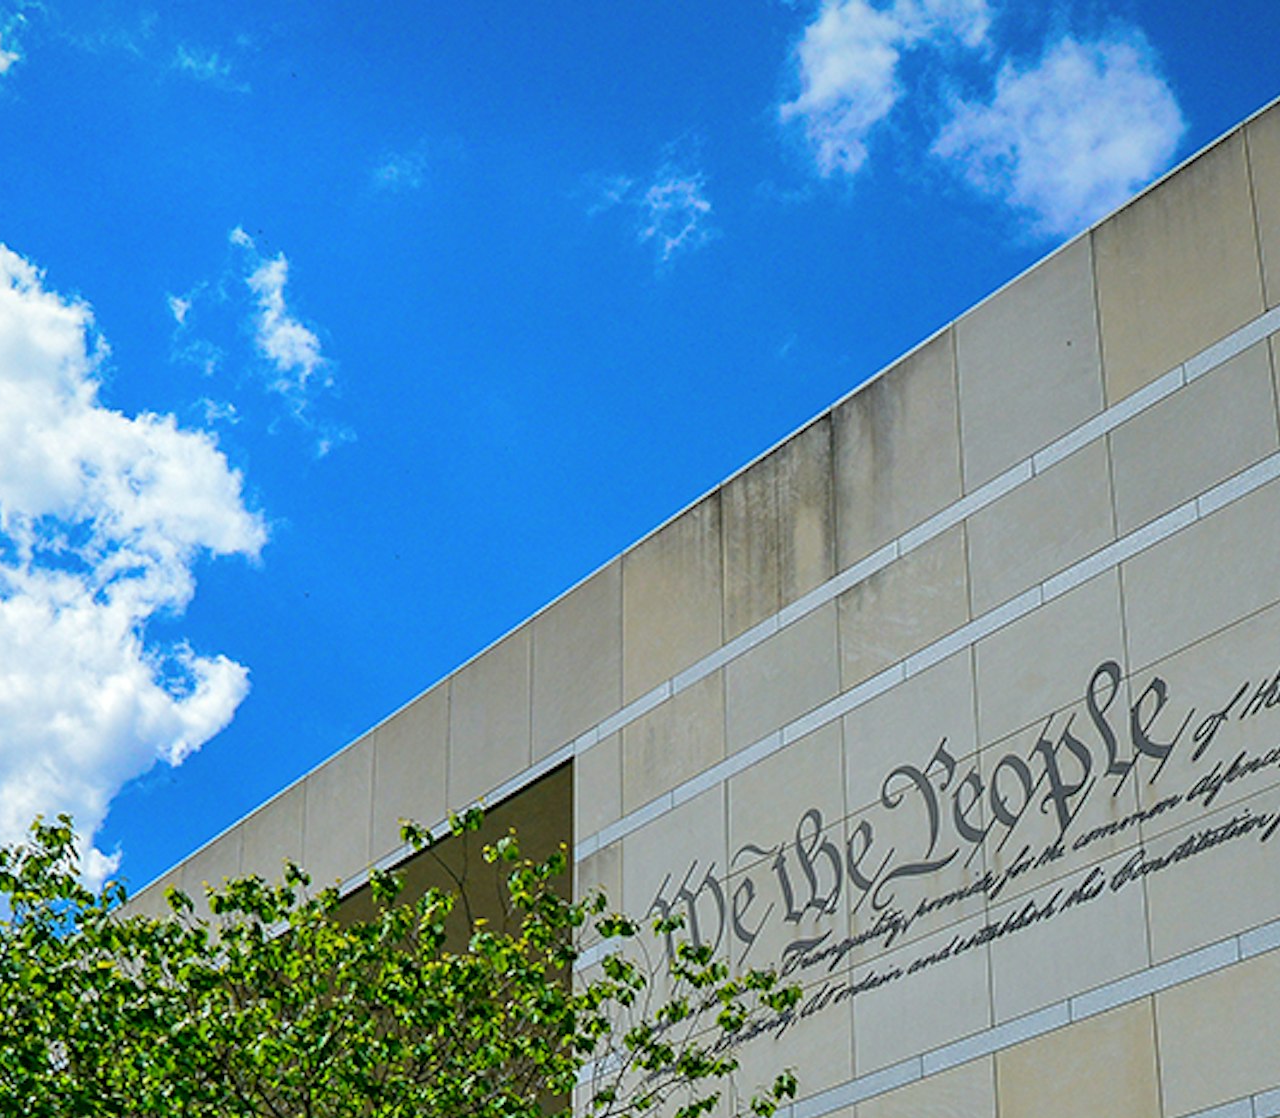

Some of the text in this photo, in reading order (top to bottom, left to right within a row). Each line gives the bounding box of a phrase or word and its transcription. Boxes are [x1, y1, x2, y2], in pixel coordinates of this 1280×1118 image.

[642, 858, 776, 992] We
[870, 659, 1196, 910] People
[1190, 680, 1250, 762] of
[834, 965, 904, 1004] ordain
[906, 935, 961, 975] and
[1059, 866, 1106, 912] this
[1109, 808, 1276, 893] Constitution
[901, 870, 1000, 933] provide
[989, 844, 1036, 900] for
[1033, 844, 1066, 869] the
[1072, 795, 1183, 851] common
